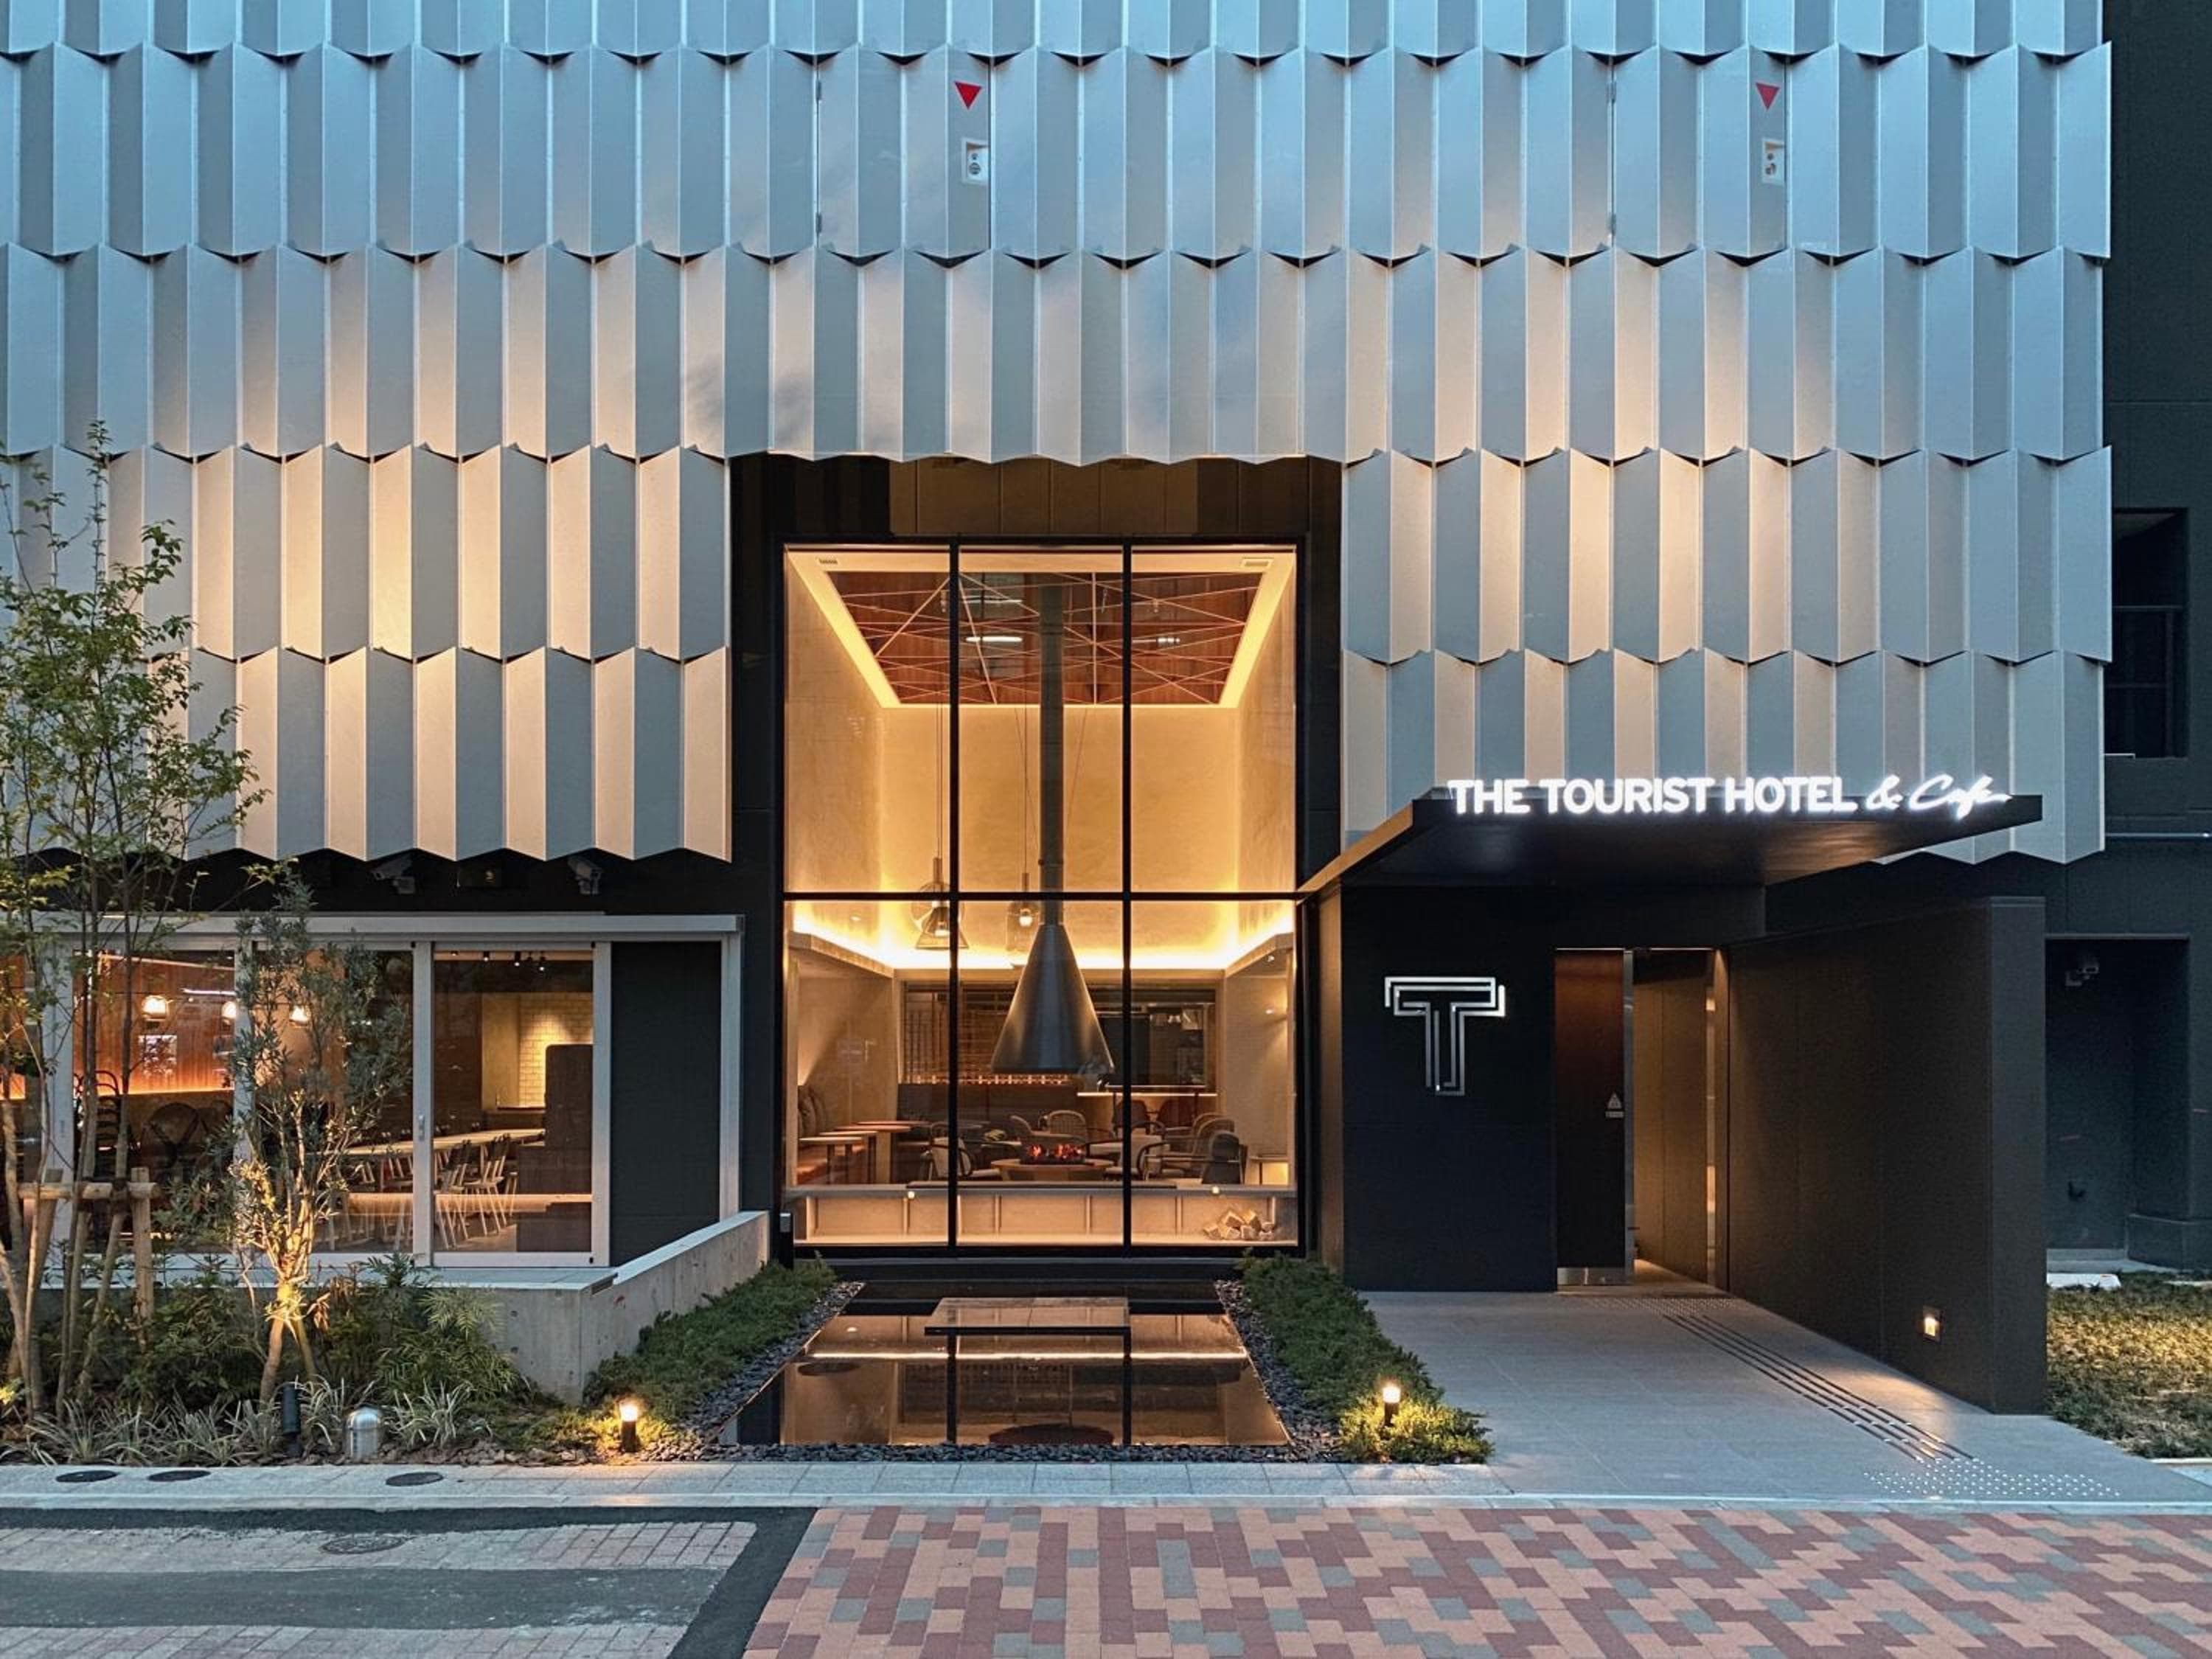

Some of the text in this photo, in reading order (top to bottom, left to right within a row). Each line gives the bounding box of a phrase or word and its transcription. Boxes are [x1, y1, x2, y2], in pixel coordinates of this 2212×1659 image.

[1447, 778, 1531, 813] THE
[1539, 777, 1716, 813] TOURIST
[1725, 776, 1858, 813] HOTEL
[1866, 775, 1904, 810] &
[1385, 976, 1505, 1096] T
